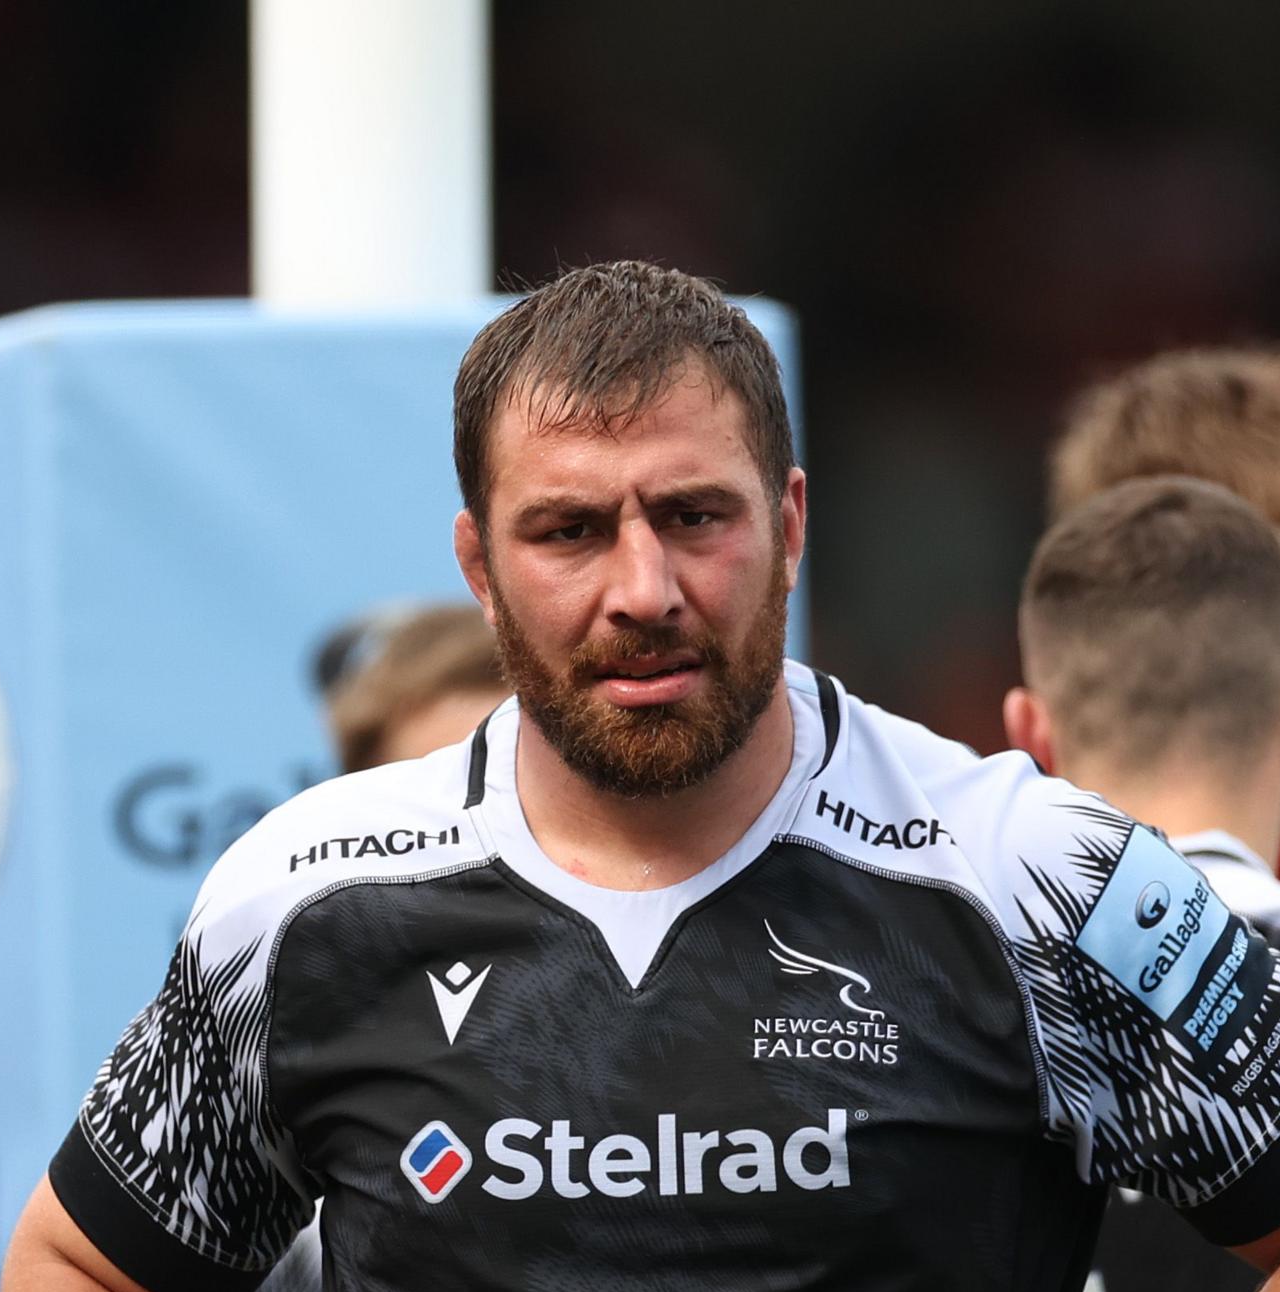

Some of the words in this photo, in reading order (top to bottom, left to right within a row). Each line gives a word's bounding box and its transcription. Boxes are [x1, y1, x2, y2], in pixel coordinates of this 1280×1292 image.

[289, 825, 460, 873] HITACHI
[1139, 880, 1209, 993] Gallagher
[1183, 927, 1249, 1037] PREMIERSHIP
[754, 1018, 899, 1040] NEWCASTLE
[1198, 981, 1244, 1051] RUGBY
[753, 1038, 898, 1064] FALCONS
[1231, 1054, 1266, 1097] RUGBY
